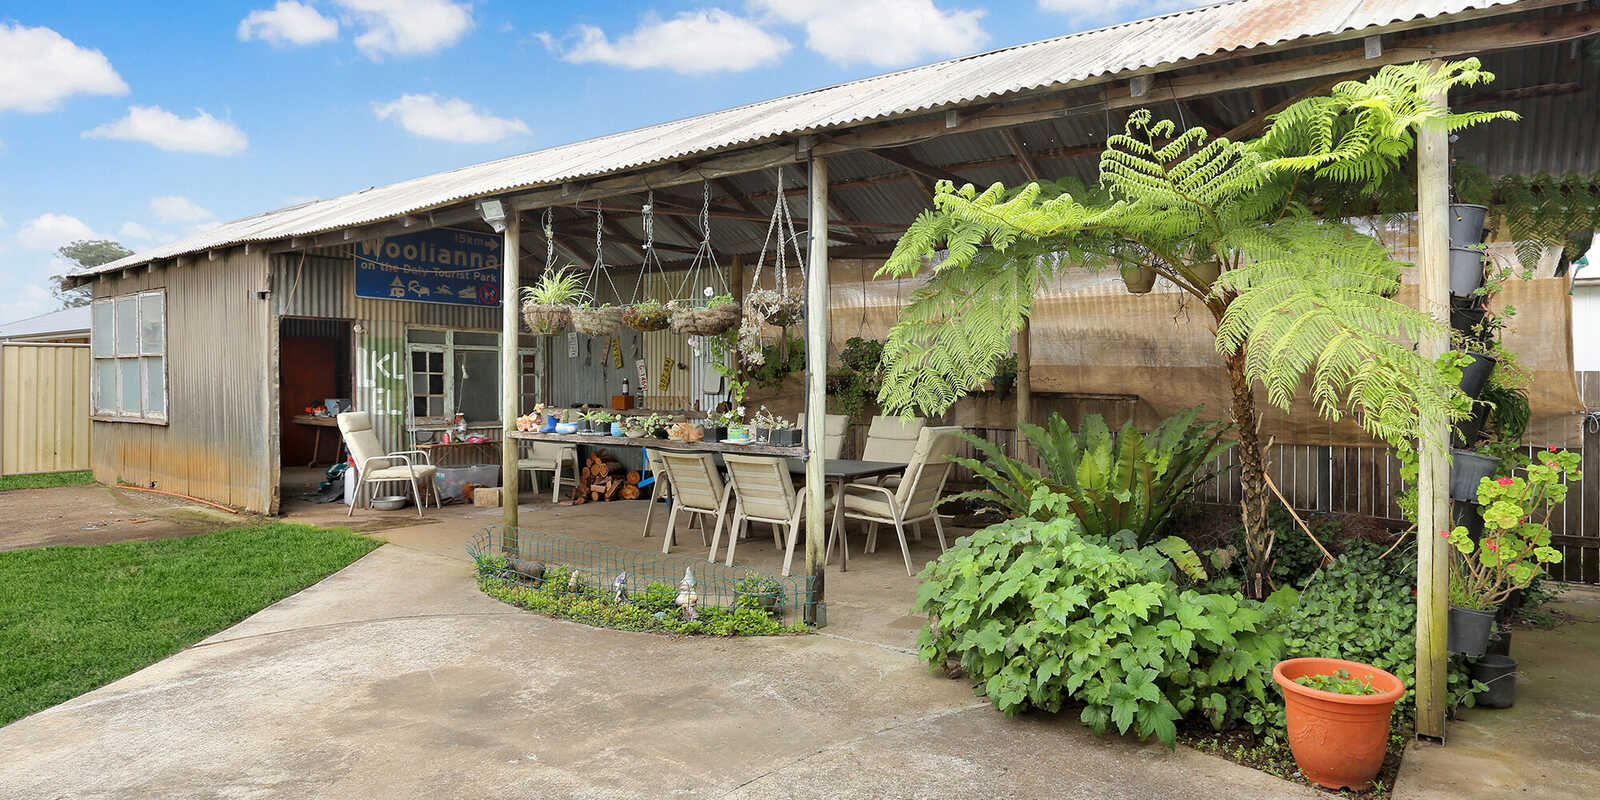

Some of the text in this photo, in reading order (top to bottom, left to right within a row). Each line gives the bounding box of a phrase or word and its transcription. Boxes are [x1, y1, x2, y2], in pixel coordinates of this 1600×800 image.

[455, 232, 484, 247] 15km
[361, 240, 498, 269] Woolianna
[360, 262, 376, 271] on
[380, 262, 399, 272] the
[433, 267, 470, 280] Tourist
[473, 271, 498, 283] Park
